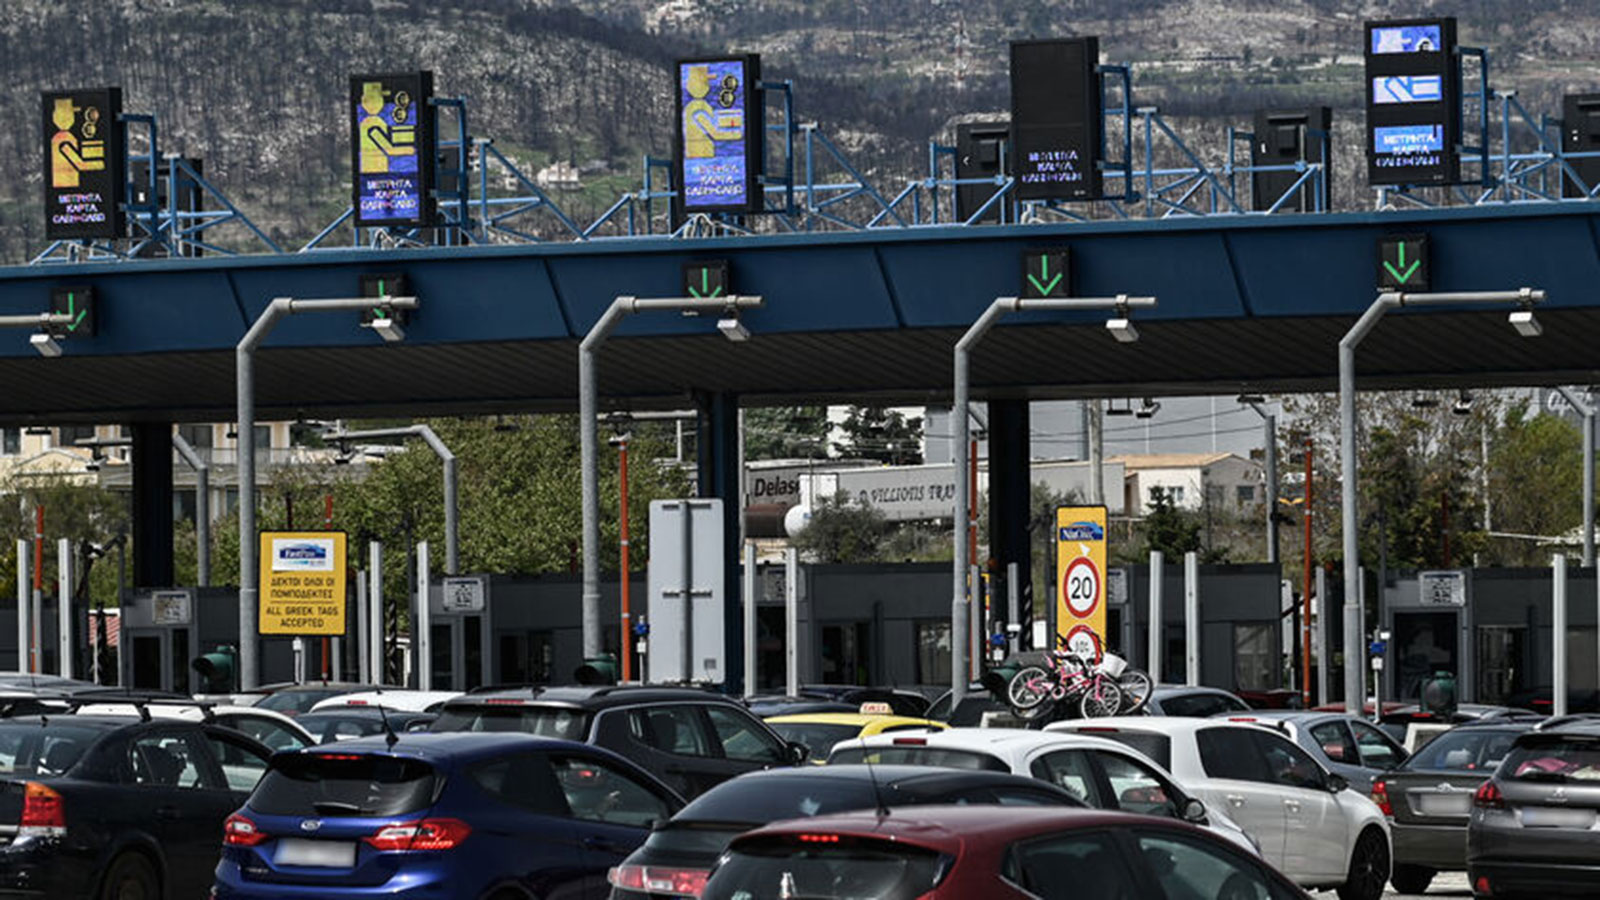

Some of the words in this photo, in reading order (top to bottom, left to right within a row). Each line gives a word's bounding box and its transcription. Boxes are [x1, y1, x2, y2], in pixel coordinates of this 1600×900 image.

[271, 577, 301, 586] ΔΕΚΤΟΙ
[326, 577, 335, 586] ΟΙ
[1071, 576, 1093, 600] 20
[270, 589, 333, 599] ΠΟΜΠΟΔΕΚΤΕΣ
[266, 606, 281, 615] ALL
[285, 606, 313, 615] GREEK
[318, 606, 339, 615] TAGS
[279, 618, 325, 628] ACCEPTED
